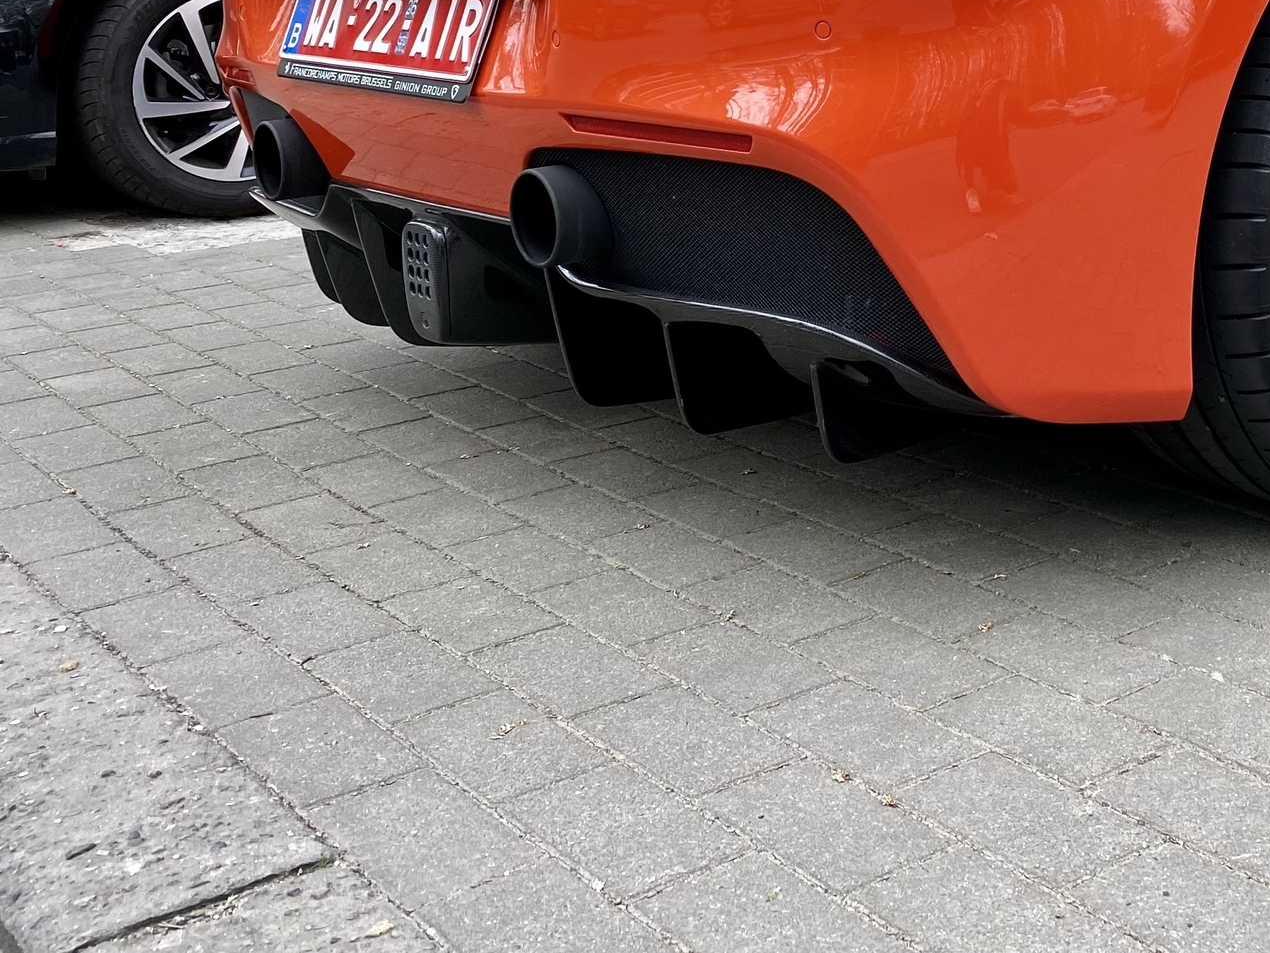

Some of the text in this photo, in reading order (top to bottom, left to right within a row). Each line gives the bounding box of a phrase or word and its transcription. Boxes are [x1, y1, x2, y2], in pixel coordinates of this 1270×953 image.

[287, 22, 302, 48] B
[289, 64, 448, 97] FRANCORCHAMPS MOTORS BRUSSELS GINION GROUP
